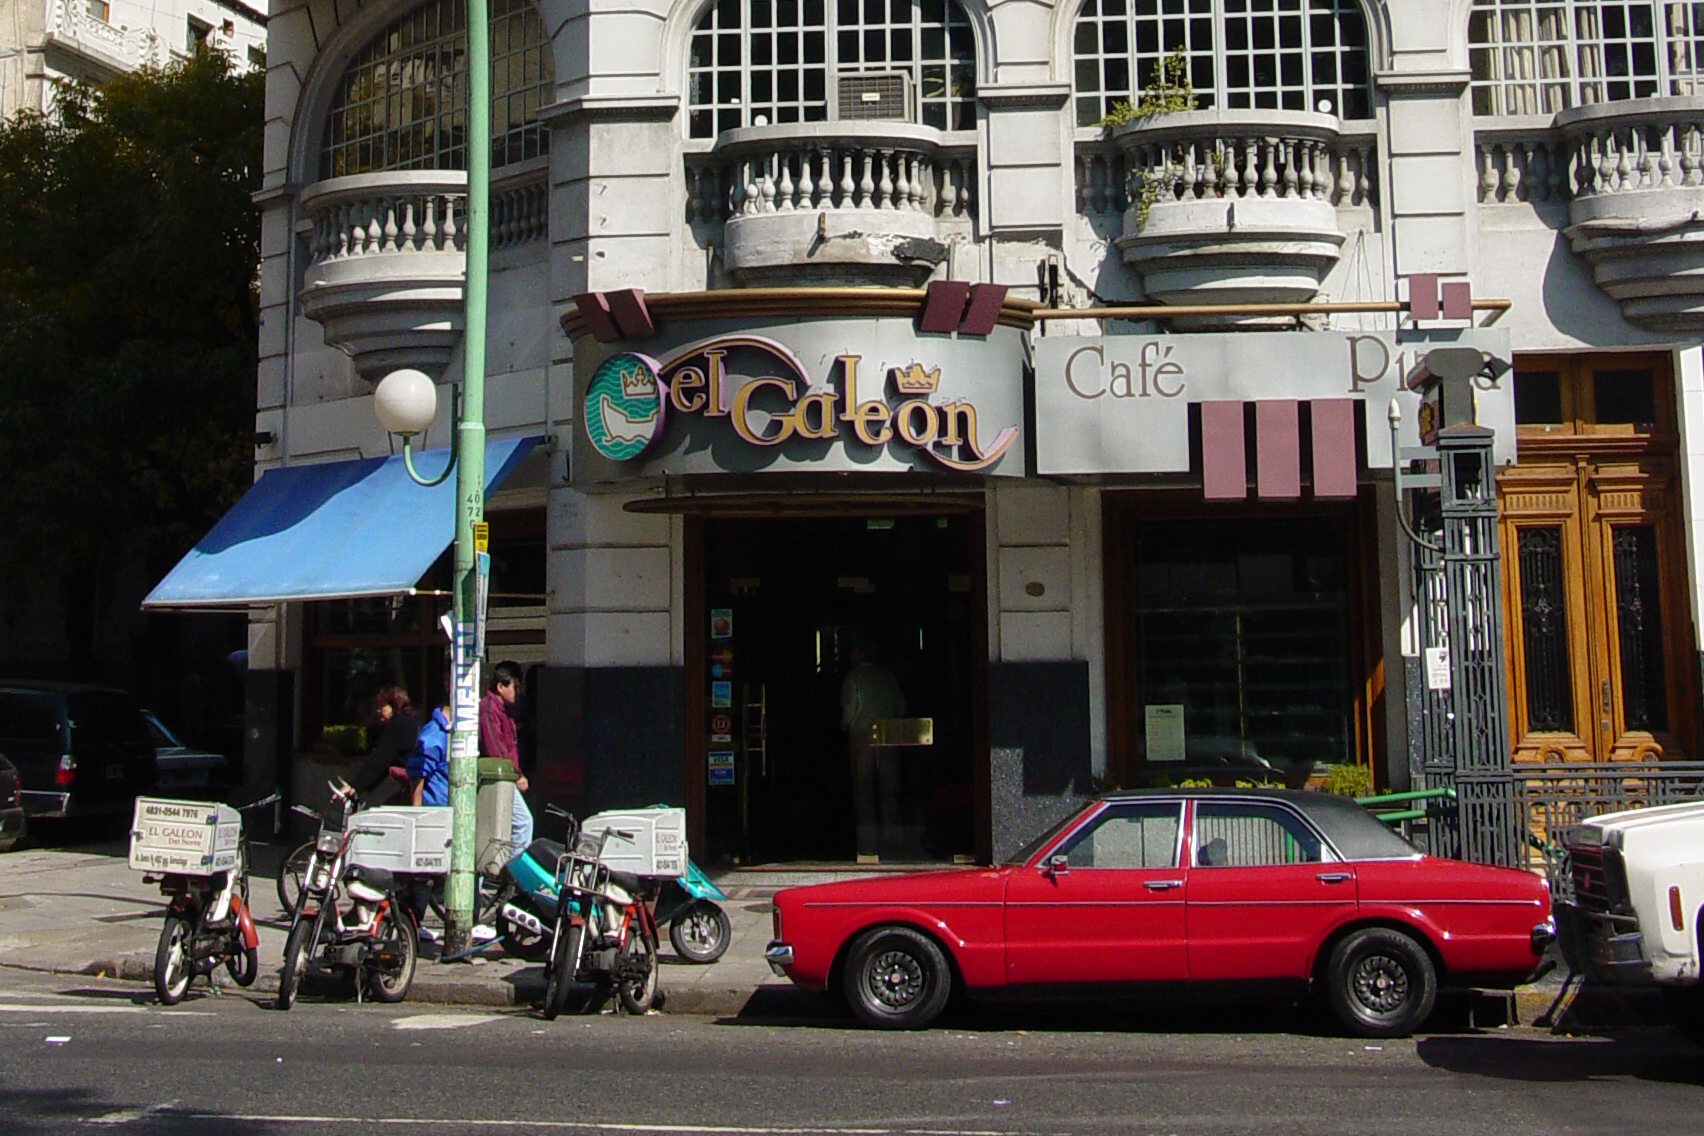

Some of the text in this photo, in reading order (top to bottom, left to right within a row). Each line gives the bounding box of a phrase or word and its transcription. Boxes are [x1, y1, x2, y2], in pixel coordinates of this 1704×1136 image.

[1065, 341, 1185, 399] Café
[1346, 335, 1501, 393] Pia
[670, 350, 1018, 470] el Galeon
[149, 826, 203, 839] EL GALEON
